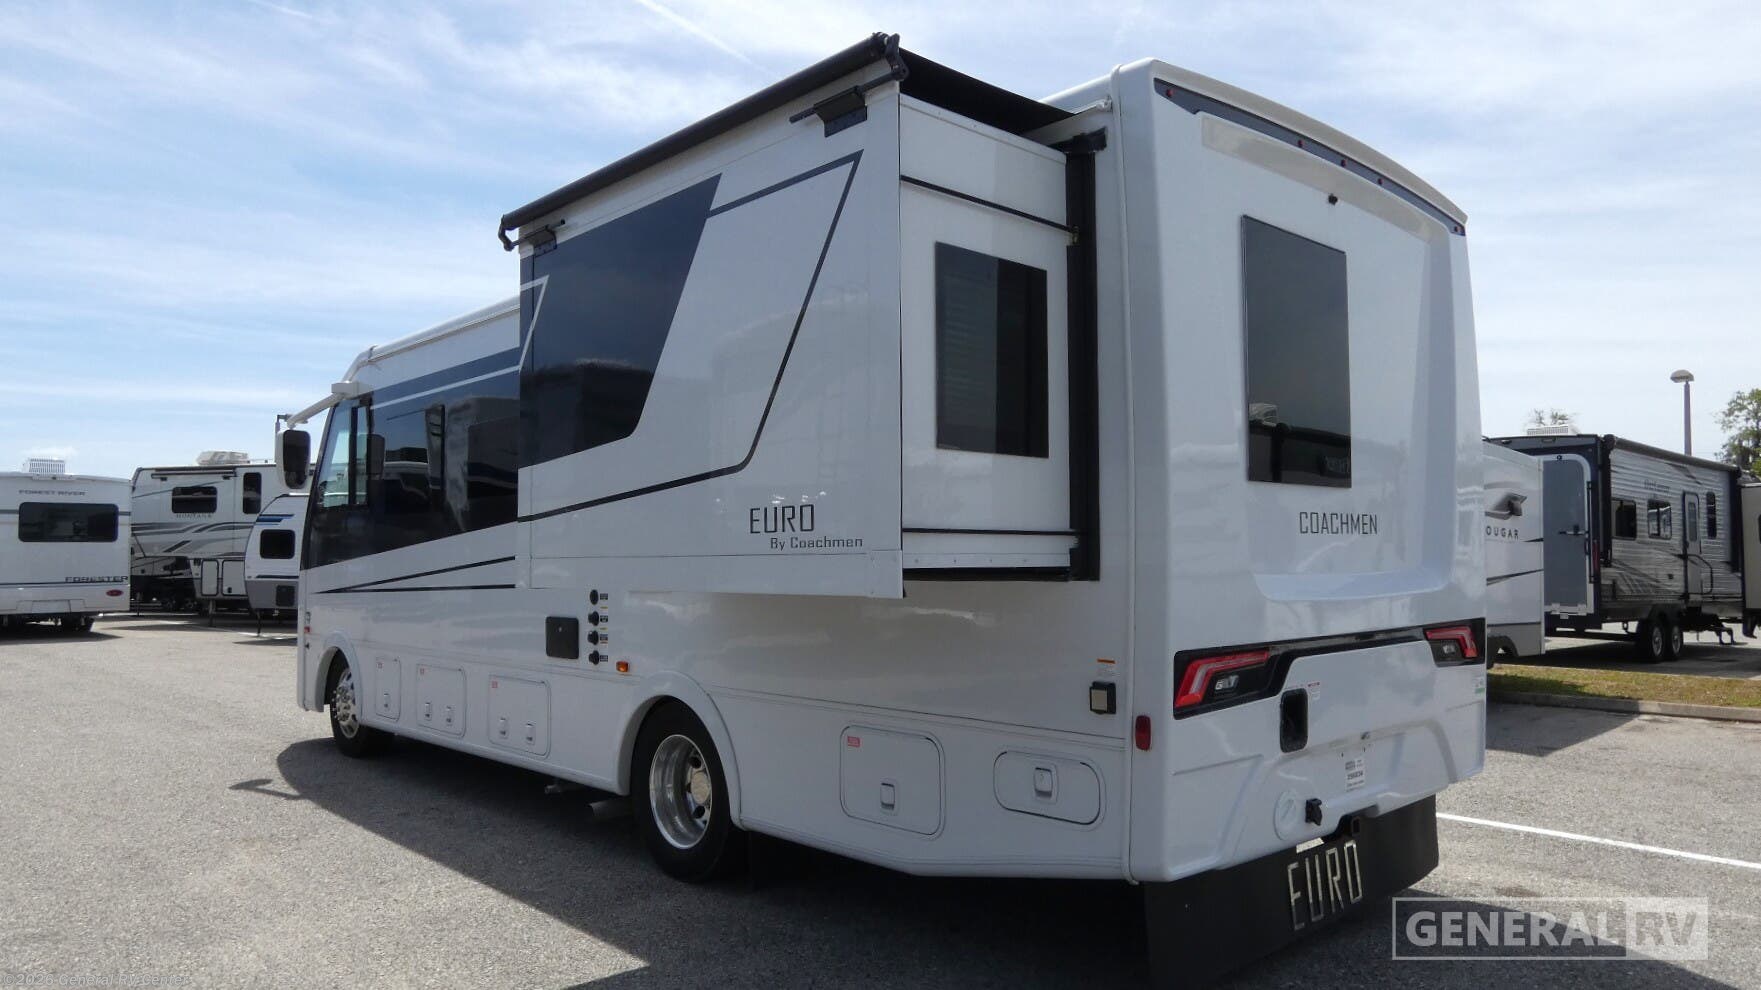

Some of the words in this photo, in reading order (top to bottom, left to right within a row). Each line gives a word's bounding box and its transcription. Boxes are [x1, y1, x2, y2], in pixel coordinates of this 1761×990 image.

[750, 504, 814, 534] EURO
[1299, 511, 1377, 535] COACHMEN
[1485, 525, 1519, 540] OUGAR
[770, 537, 785, 551] By
[790, 536, 863, 549] Coachmen
[65, 575, 128, 583] FORESTER
[1287, 839, 1363, 931] EURO
